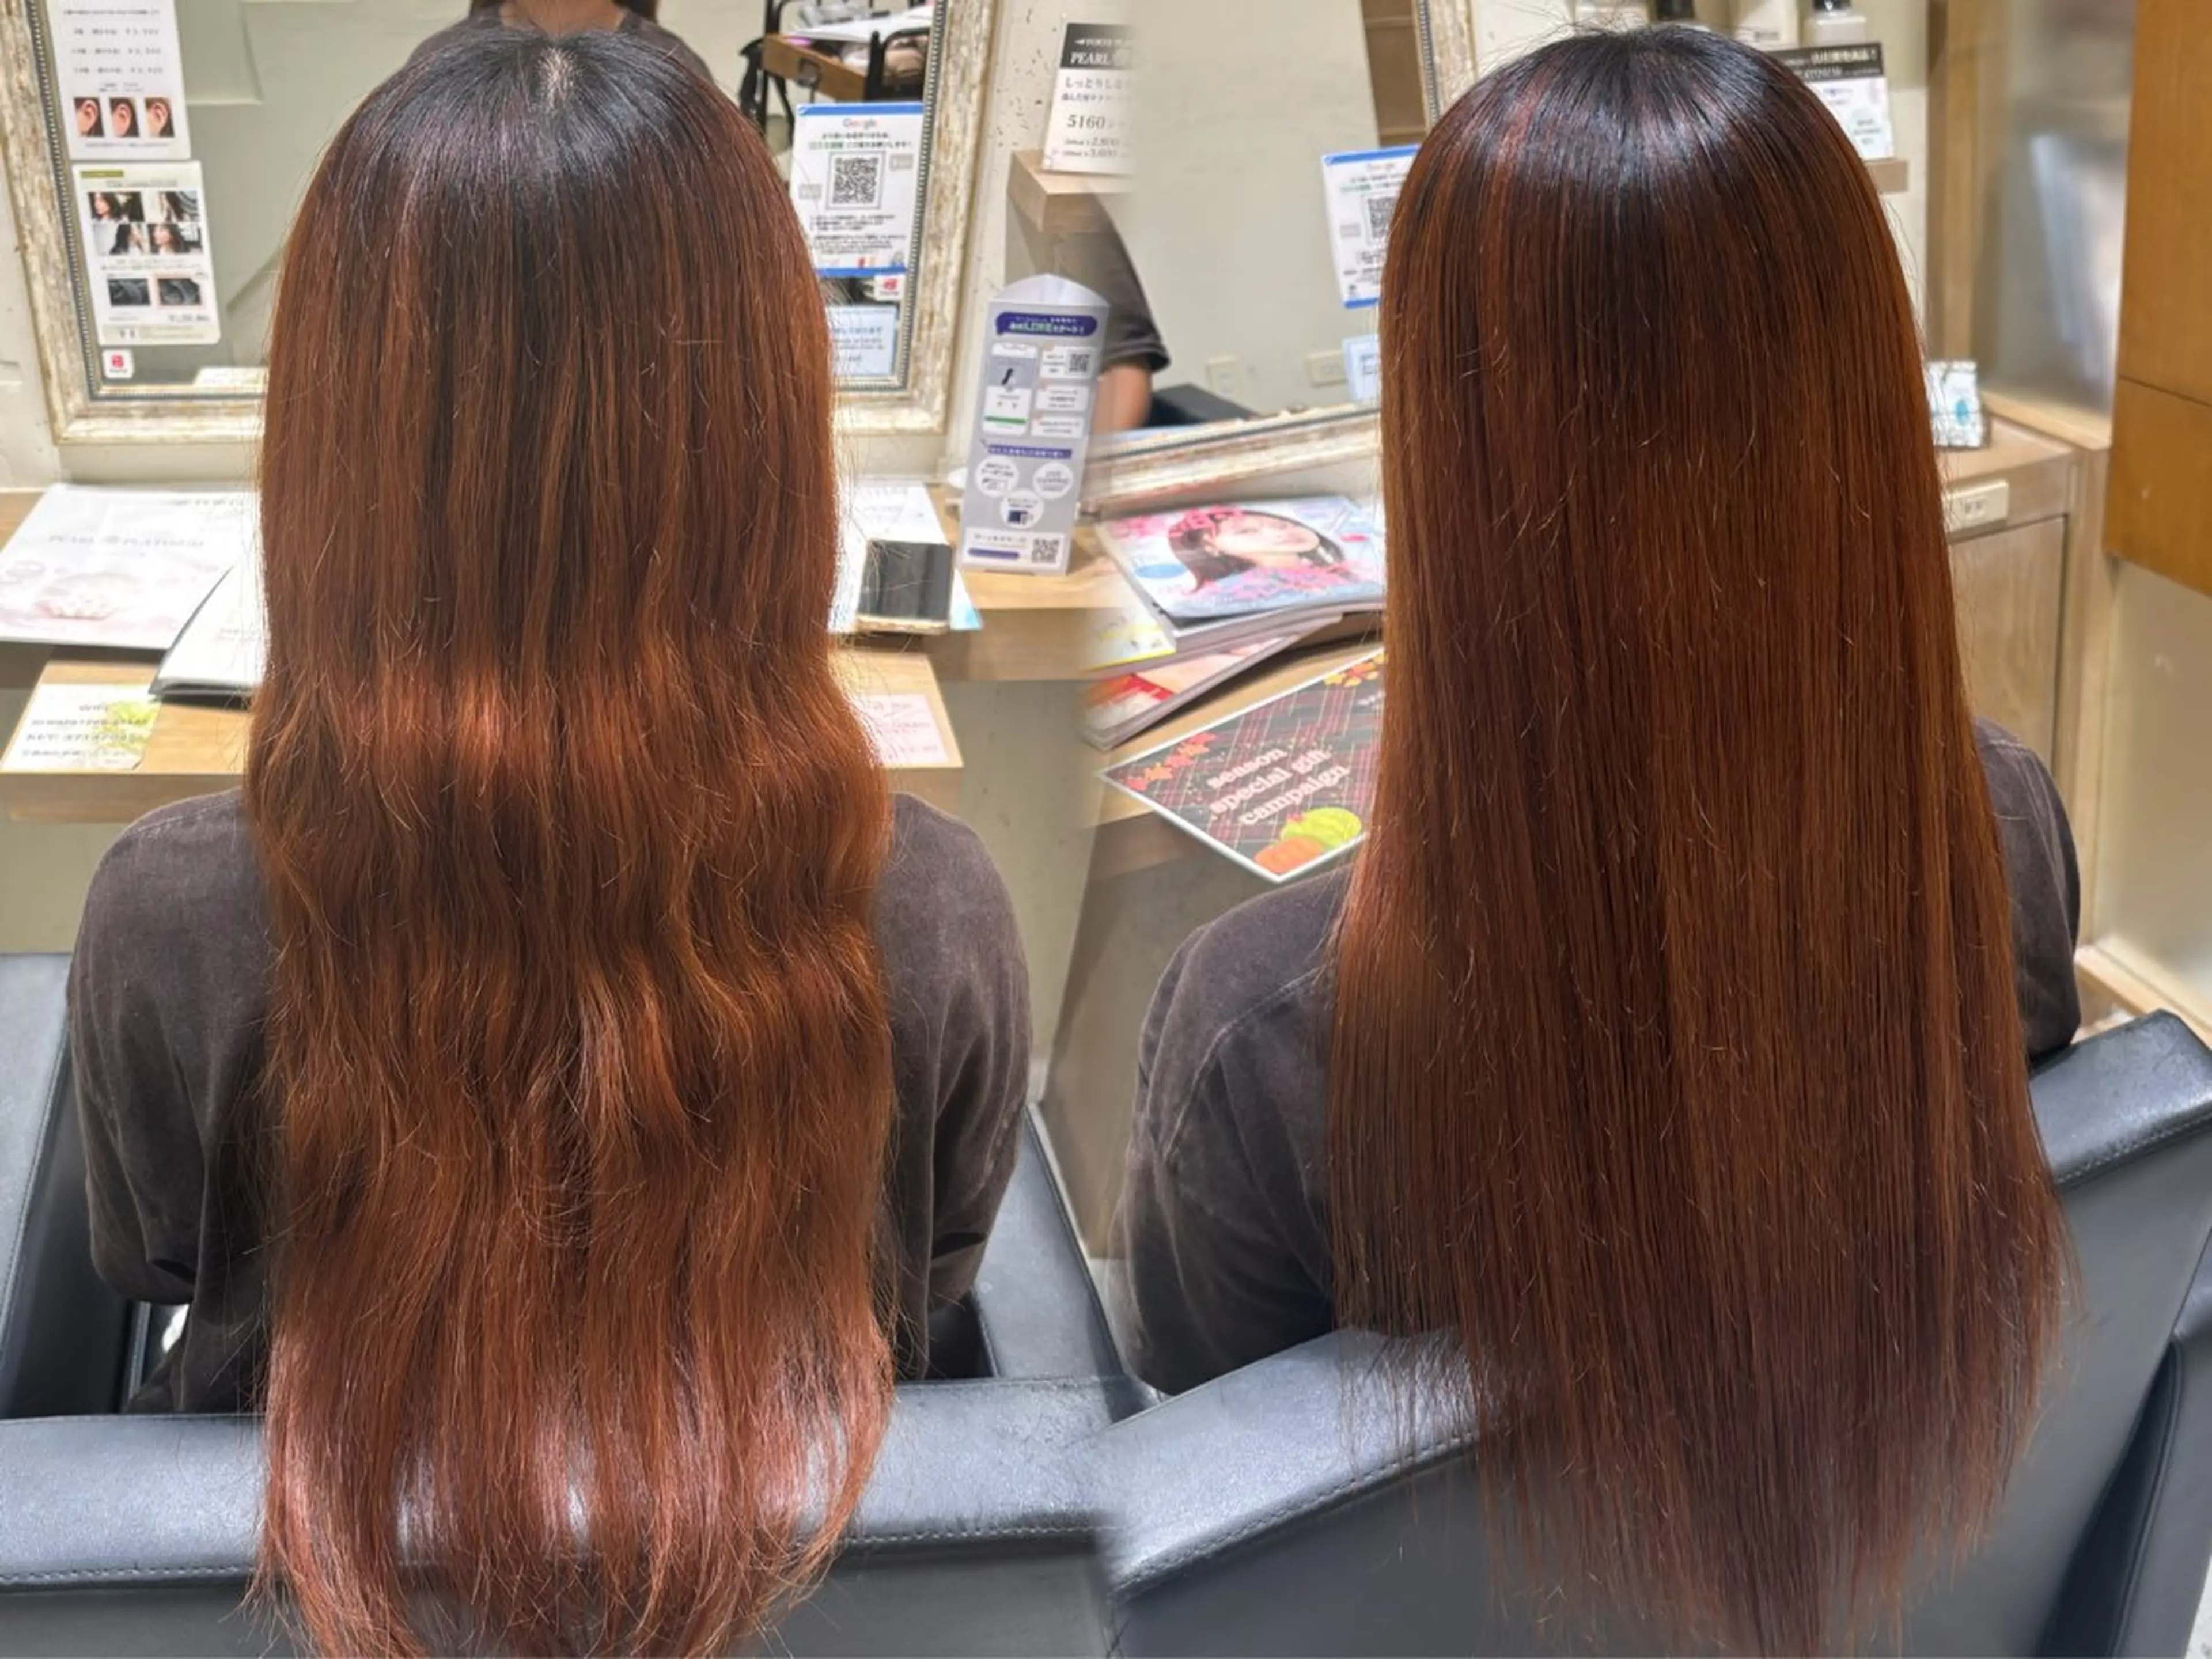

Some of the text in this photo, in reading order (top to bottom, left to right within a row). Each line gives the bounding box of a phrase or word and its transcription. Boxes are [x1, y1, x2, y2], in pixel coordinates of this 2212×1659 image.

[1070, 51, 1110, 65] PEARL
[1066, 114, 1106, 130] 5160
[1206, 749, 1288, 789] season
[1210, 767, 1293, 814] special
[1239, 765, 1351, 825] campaign
